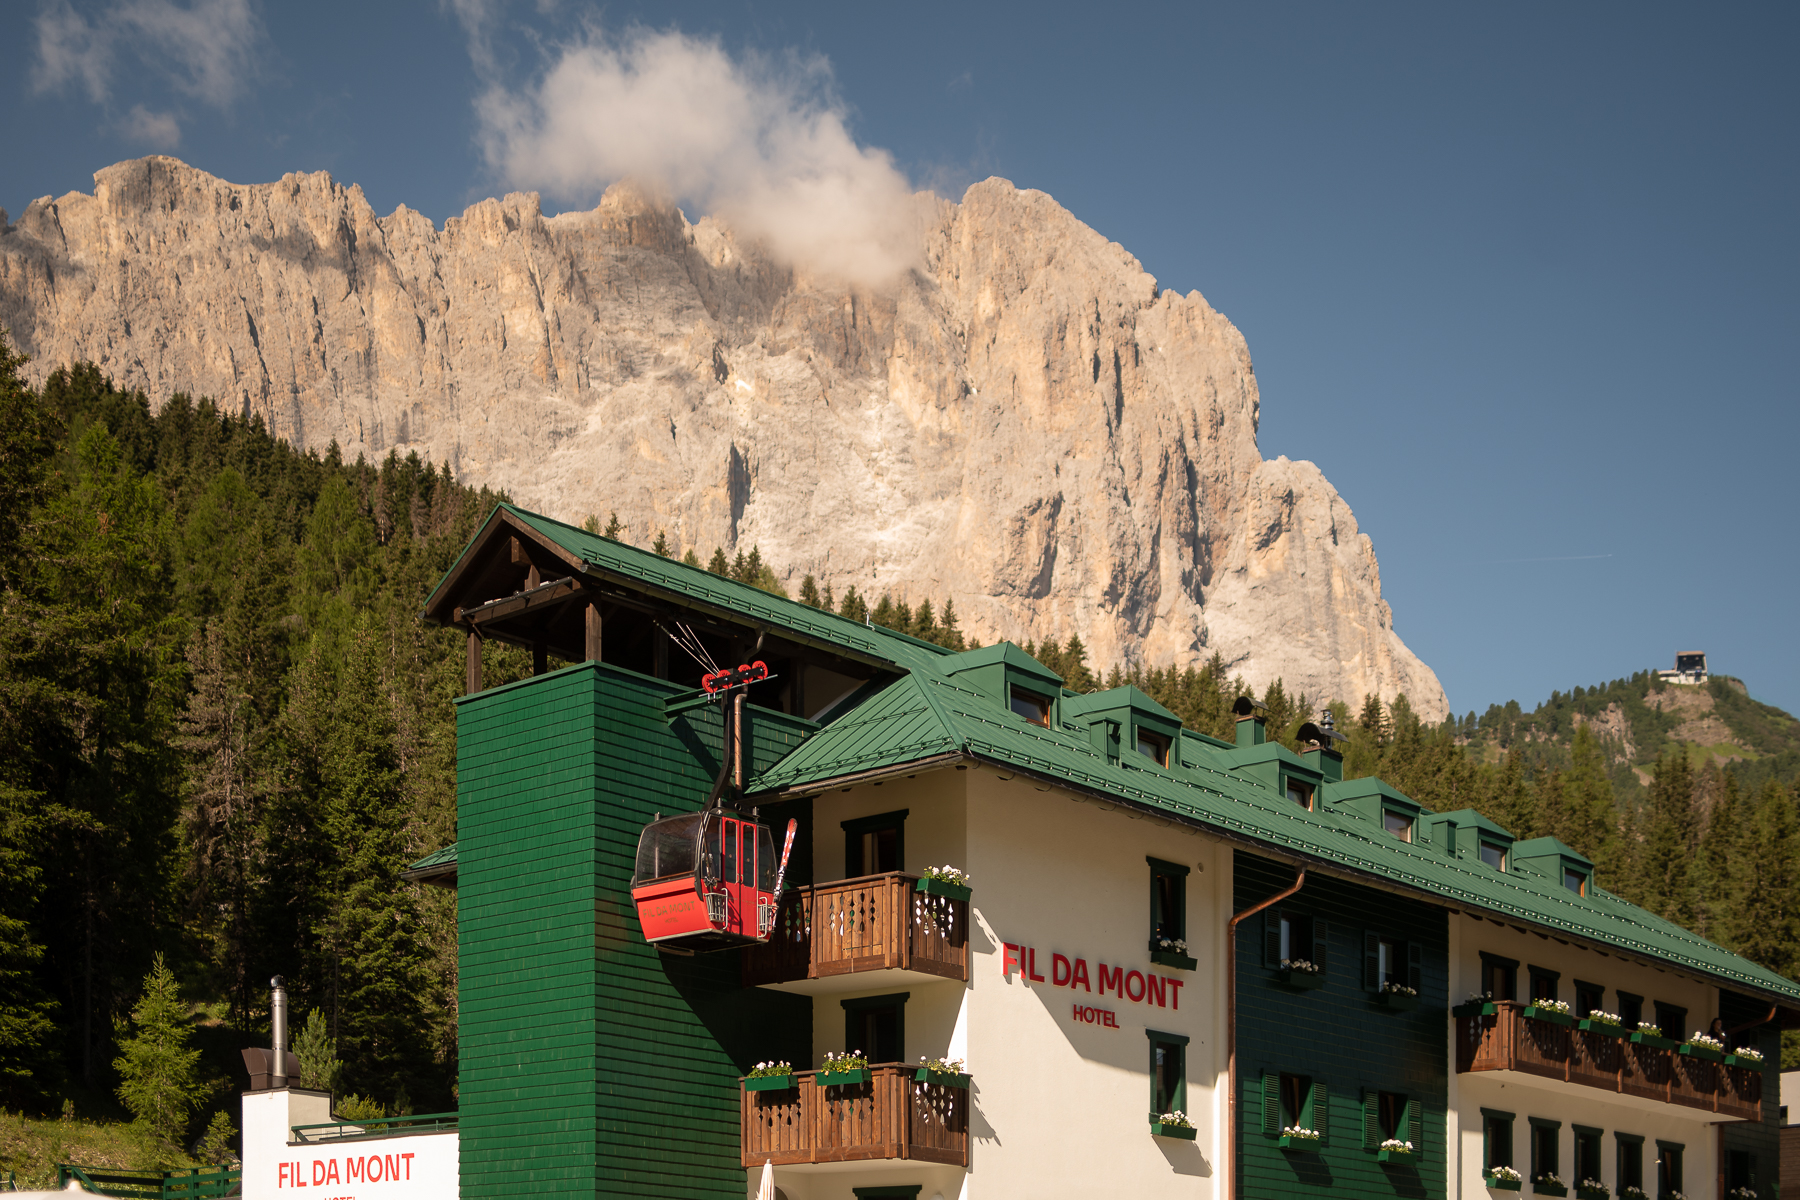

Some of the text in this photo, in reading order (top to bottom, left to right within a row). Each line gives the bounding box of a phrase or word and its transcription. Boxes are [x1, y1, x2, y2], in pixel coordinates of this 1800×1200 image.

[642, 901, 695, 919] FIL DA MONT
[1002, 942, 1184, 1010] FIL DA MONT
[1073, 1004, 1120, 1029] HOTEL
[278, 1152, 415, 1188] FIL DA MONT
